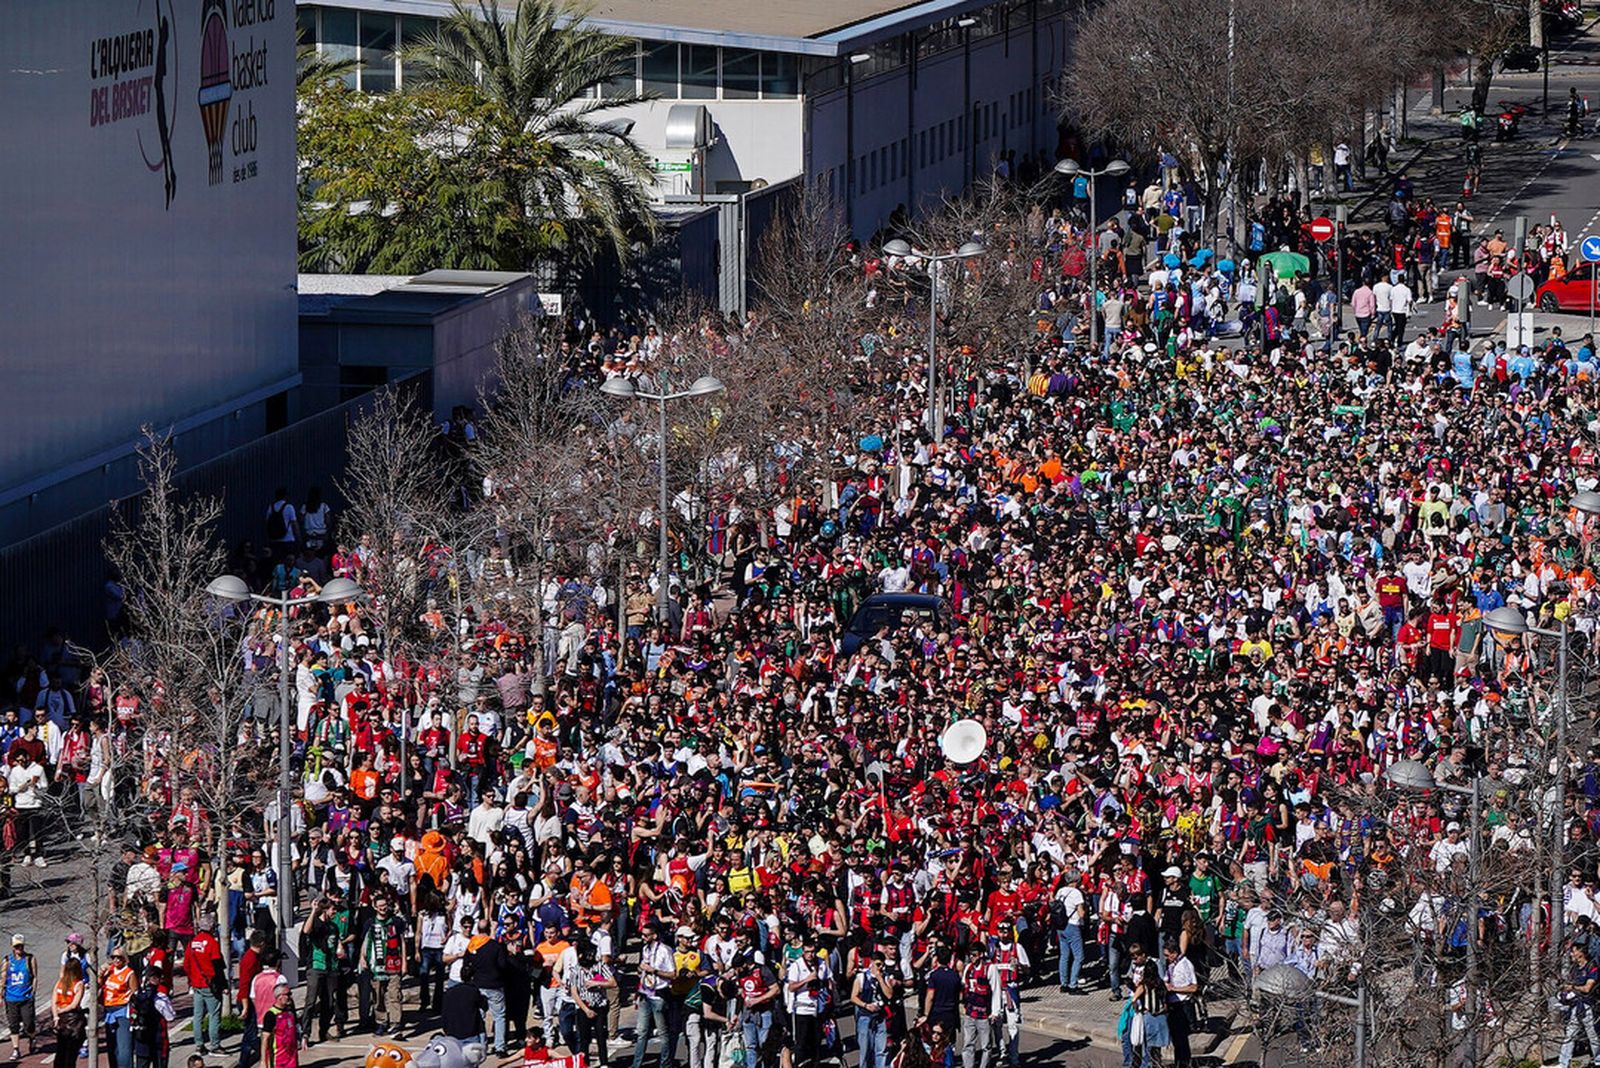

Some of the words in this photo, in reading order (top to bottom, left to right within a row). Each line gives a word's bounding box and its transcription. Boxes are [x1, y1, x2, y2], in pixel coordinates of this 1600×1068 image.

[91, 29, 153, 79] L'ALQUERIA
[232, 36, 268, 91] basket
[91, 86, 110, 127] DEL
[112, 77, 153, 122] BASKET
[232, 101, 257, 156] club
